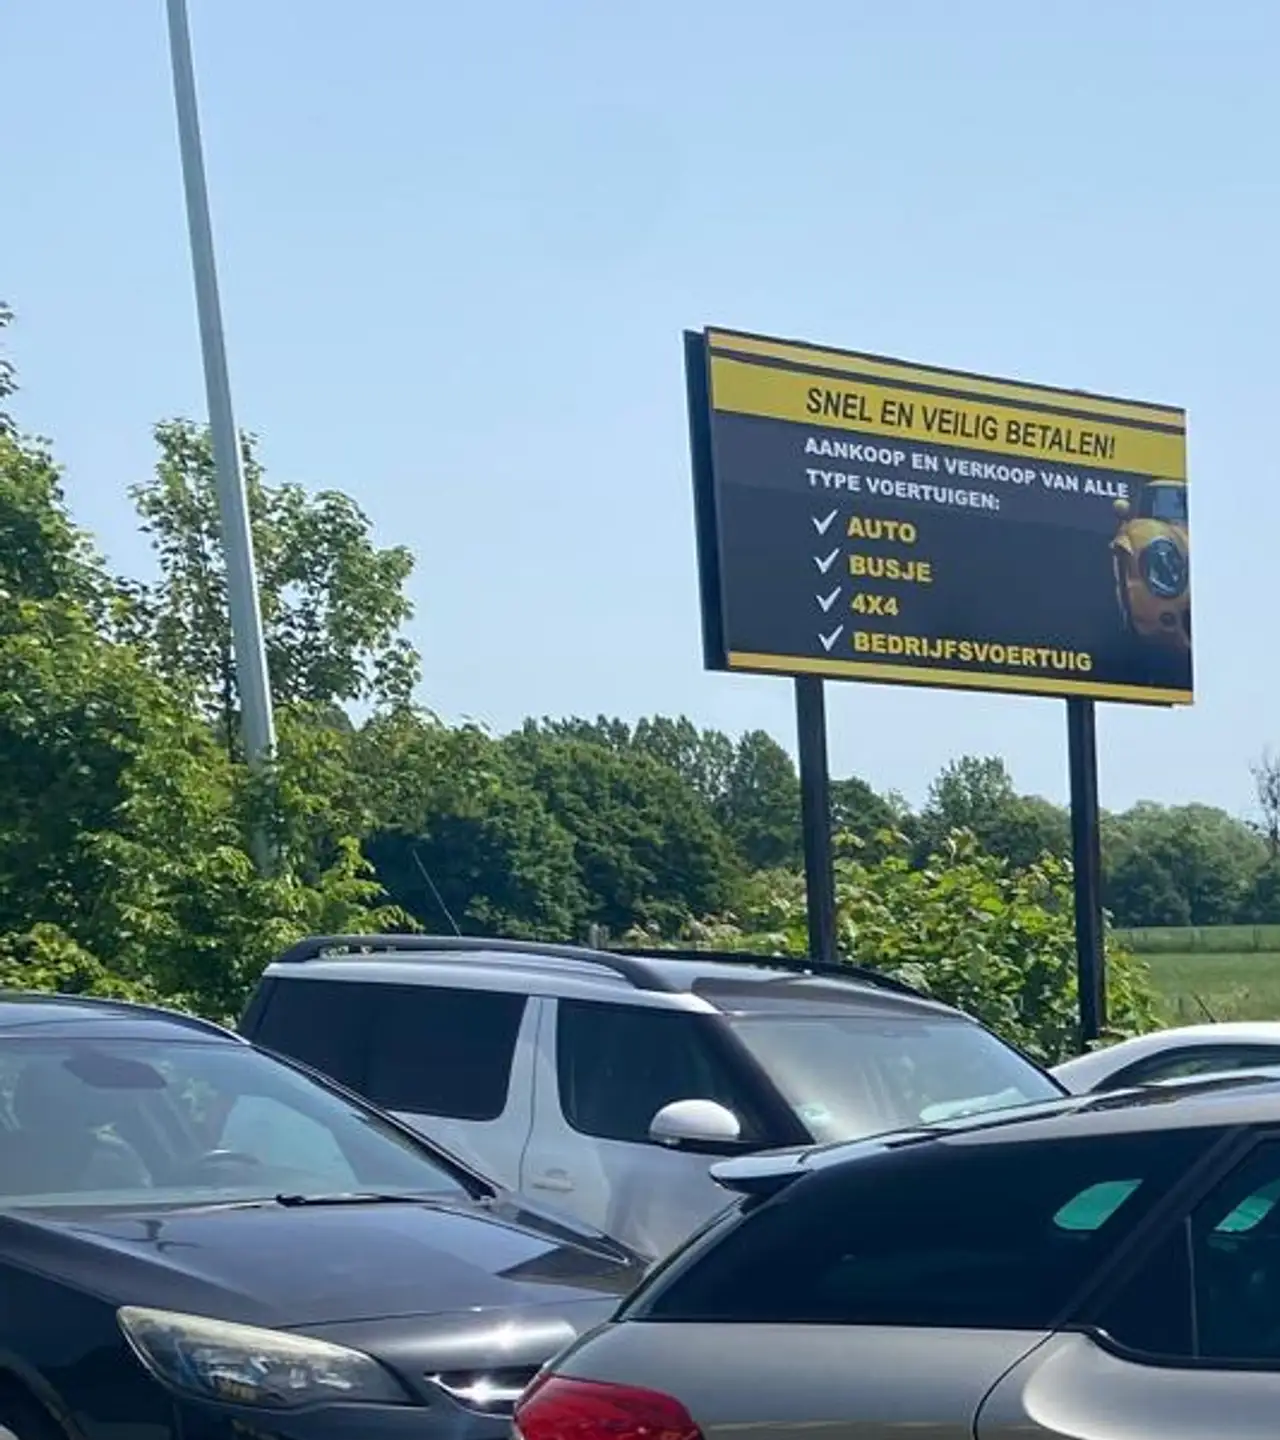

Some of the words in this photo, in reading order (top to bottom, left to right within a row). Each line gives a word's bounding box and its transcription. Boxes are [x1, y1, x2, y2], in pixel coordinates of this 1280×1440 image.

[806, 387, 873, 424] SNEL
[881, 399, 915, 429] EN
[922, 405, 999, 442] VEILIG
[1006, 419, 1117, 460] BETALEN!
[804, 437, 906, 468] AANKOOP
[912, 452, 939, 473] EN
[944, 456, 1036, 486] VERKOOP
[1040, 471, 1079, 493] VAN
[1084, 477, 1129, 499] ALLE
[806, 468, 862, 492] TYPE
[866, 476, 1000, 510] VOERTUIGEN:
[847, 516, 917, 544] AUTO
[850, 554, 933, 583] BUSJE
[851, 593, 900, 616] 4X4
[853, 631, 1093, 672] BEDRIJFSVOERTUIG
